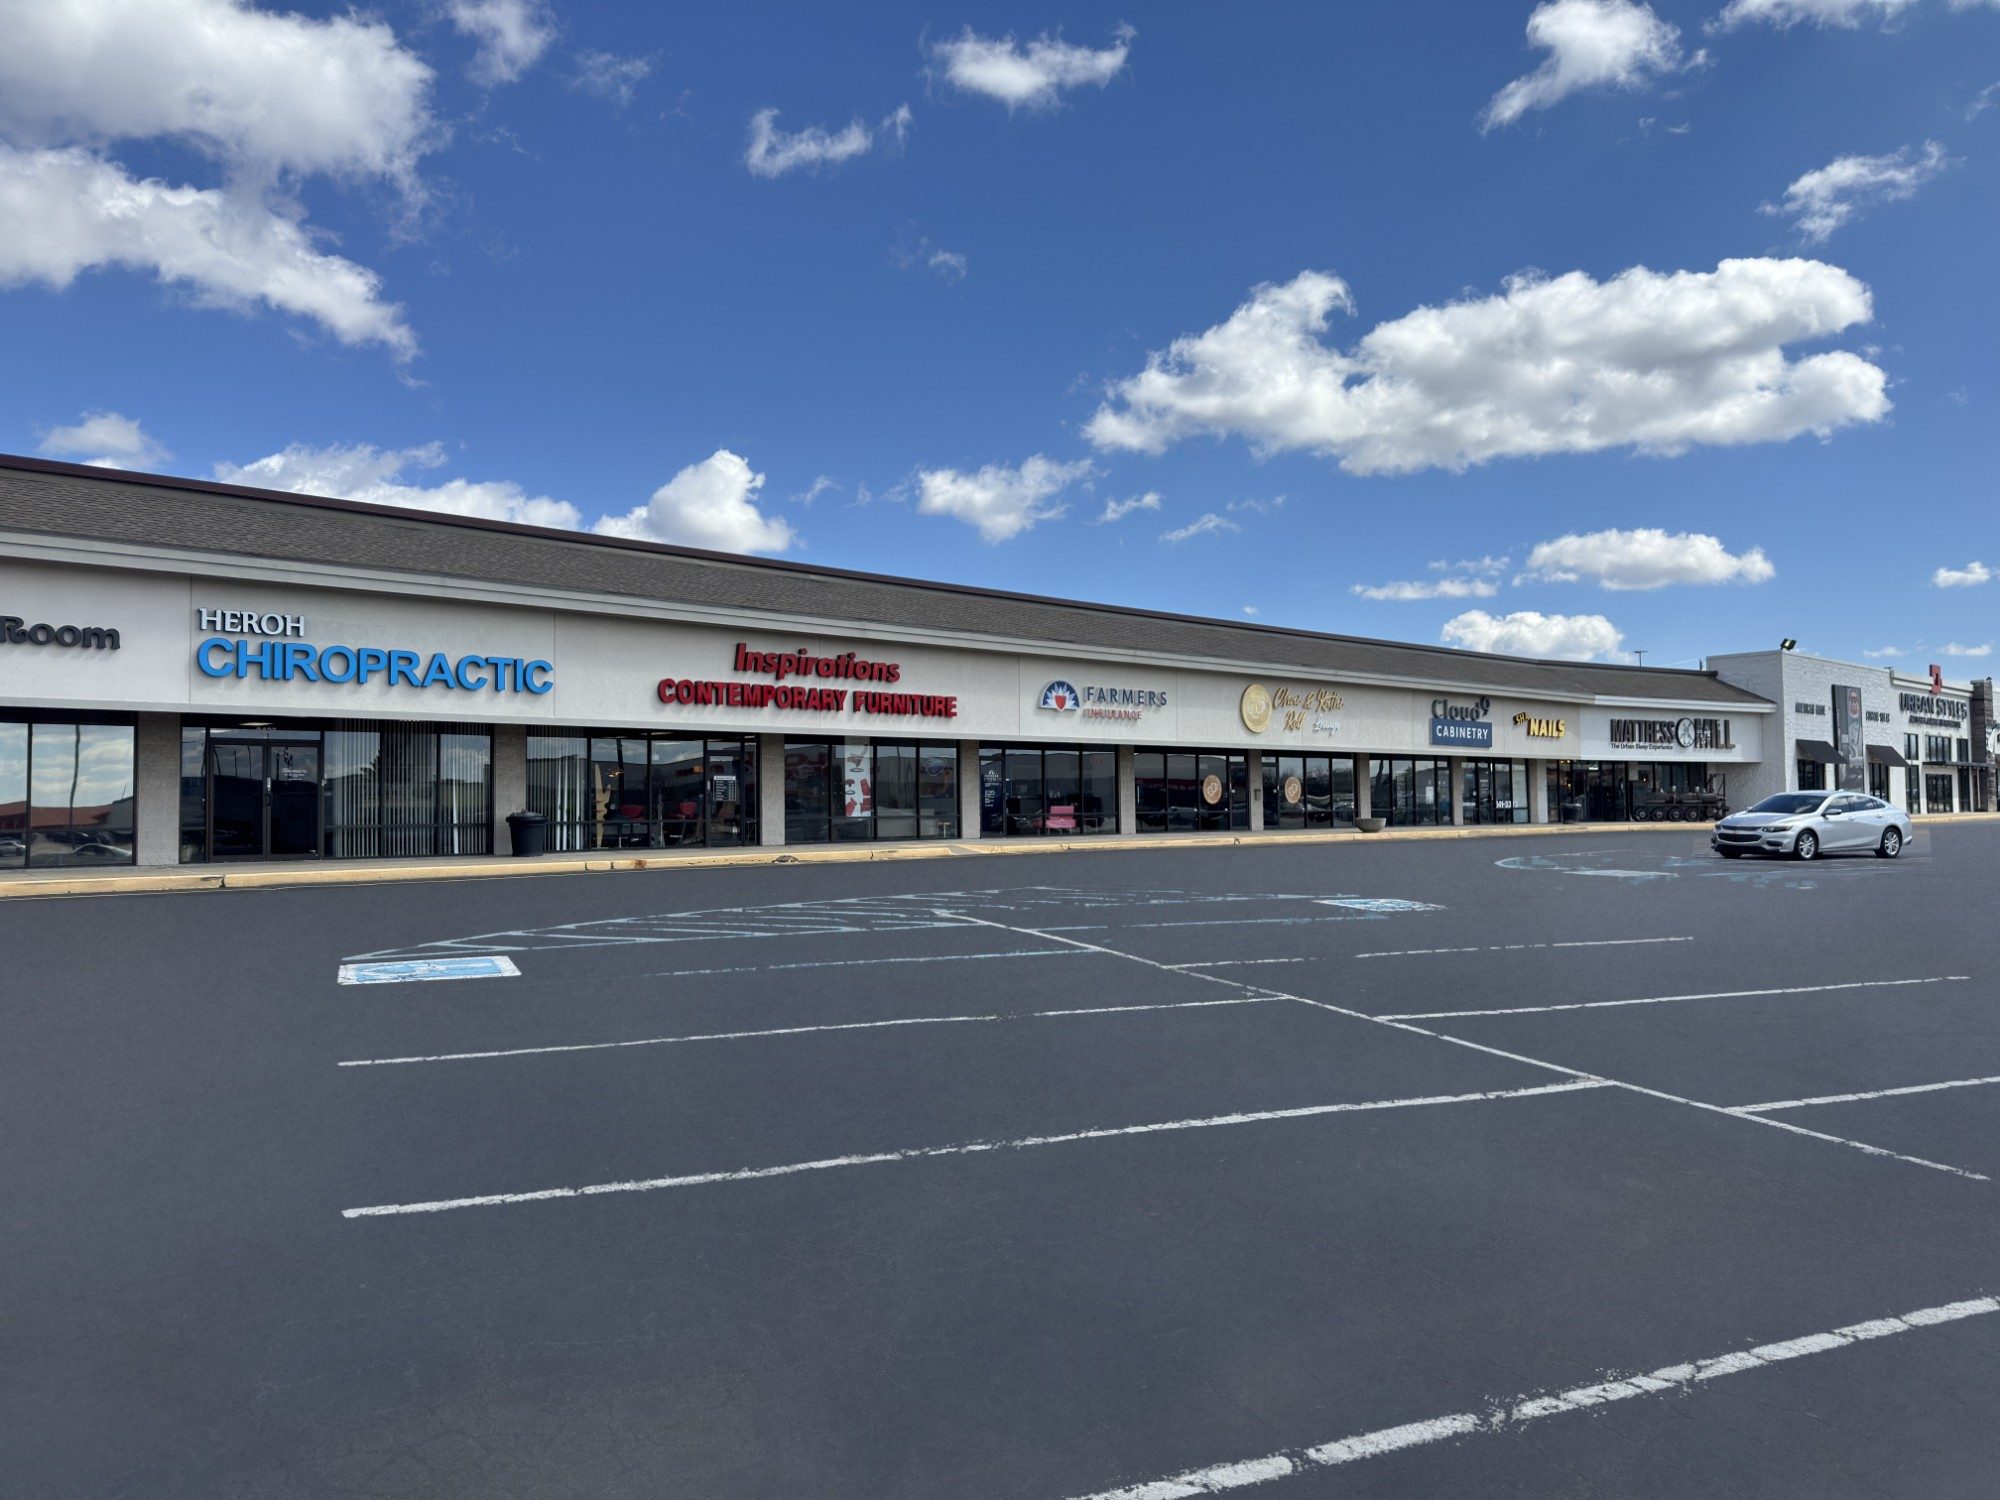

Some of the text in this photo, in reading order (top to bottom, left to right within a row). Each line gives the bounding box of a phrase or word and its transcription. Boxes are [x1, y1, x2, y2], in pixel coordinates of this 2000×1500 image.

[0, 615, 120, 650] Room
[199, 608, 305, 637] HEROH
[197, 638, 554, 694] CHIROPRACTIC
[734, 642, 900, 682] Inspirations
[657, 678, 957, 717] CONTEMPORARY FURNITURE
[1084, 686, 1167, 706] FARMERS
[1431, 698, 1480, 721] Cloud
[1084, 708, 1142, 720] INSURANCE
[1527, 718, 1565, 738] NAILS
[1436, 725, 1488, 740] CABINETRY
[1610, 718, 1735, 749] MATTRESS MILL
